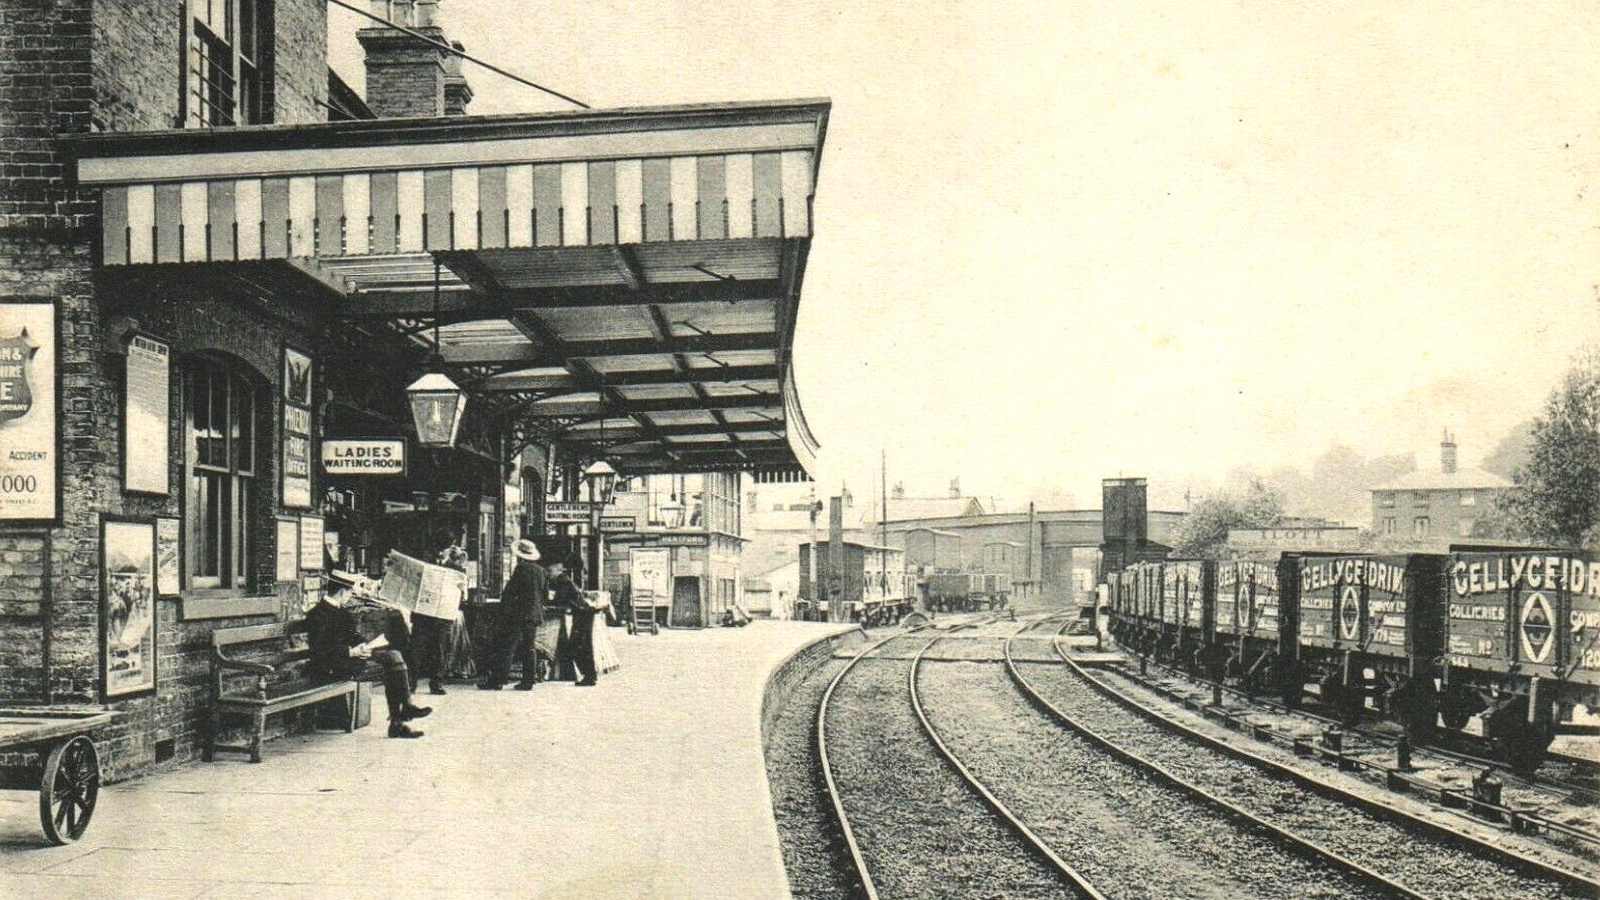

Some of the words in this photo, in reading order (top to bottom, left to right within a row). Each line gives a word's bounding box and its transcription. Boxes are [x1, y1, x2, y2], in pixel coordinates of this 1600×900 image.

[12, 347, 23, 361] &
[9, 451, 47, 460] ACCIDENT
[324, 460, 371, 468] WAITING
[372, 459, 402, 468] ROOM
[0, 475, 36, 492] 000
[1449, 603, 1505, 620] COLLIERIES
